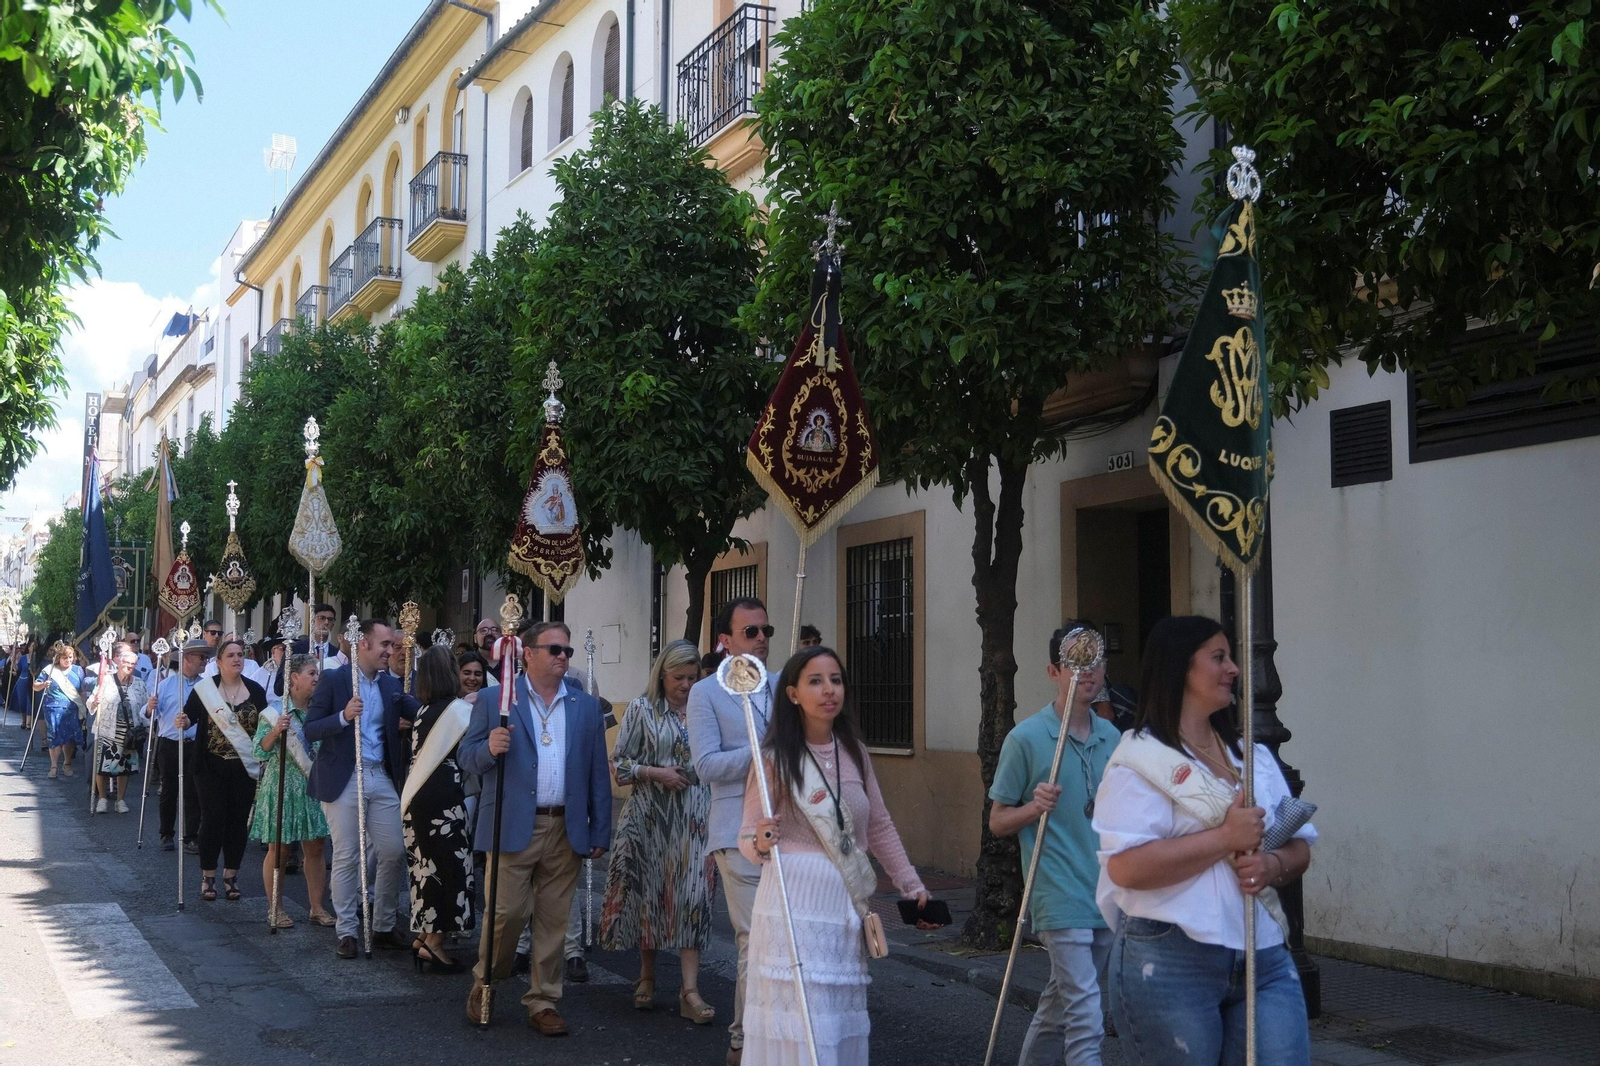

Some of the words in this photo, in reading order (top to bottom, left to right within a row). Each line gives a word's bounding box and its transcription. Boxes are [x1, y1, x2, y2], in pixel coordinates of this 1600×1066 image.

[88, 396, 98, 446] HOTEL
[797, 454, 833, 463] BUJALANCE
[1218, 449, 1262, 471] LUQUE
[528, 542, 555, 556] CABRA
